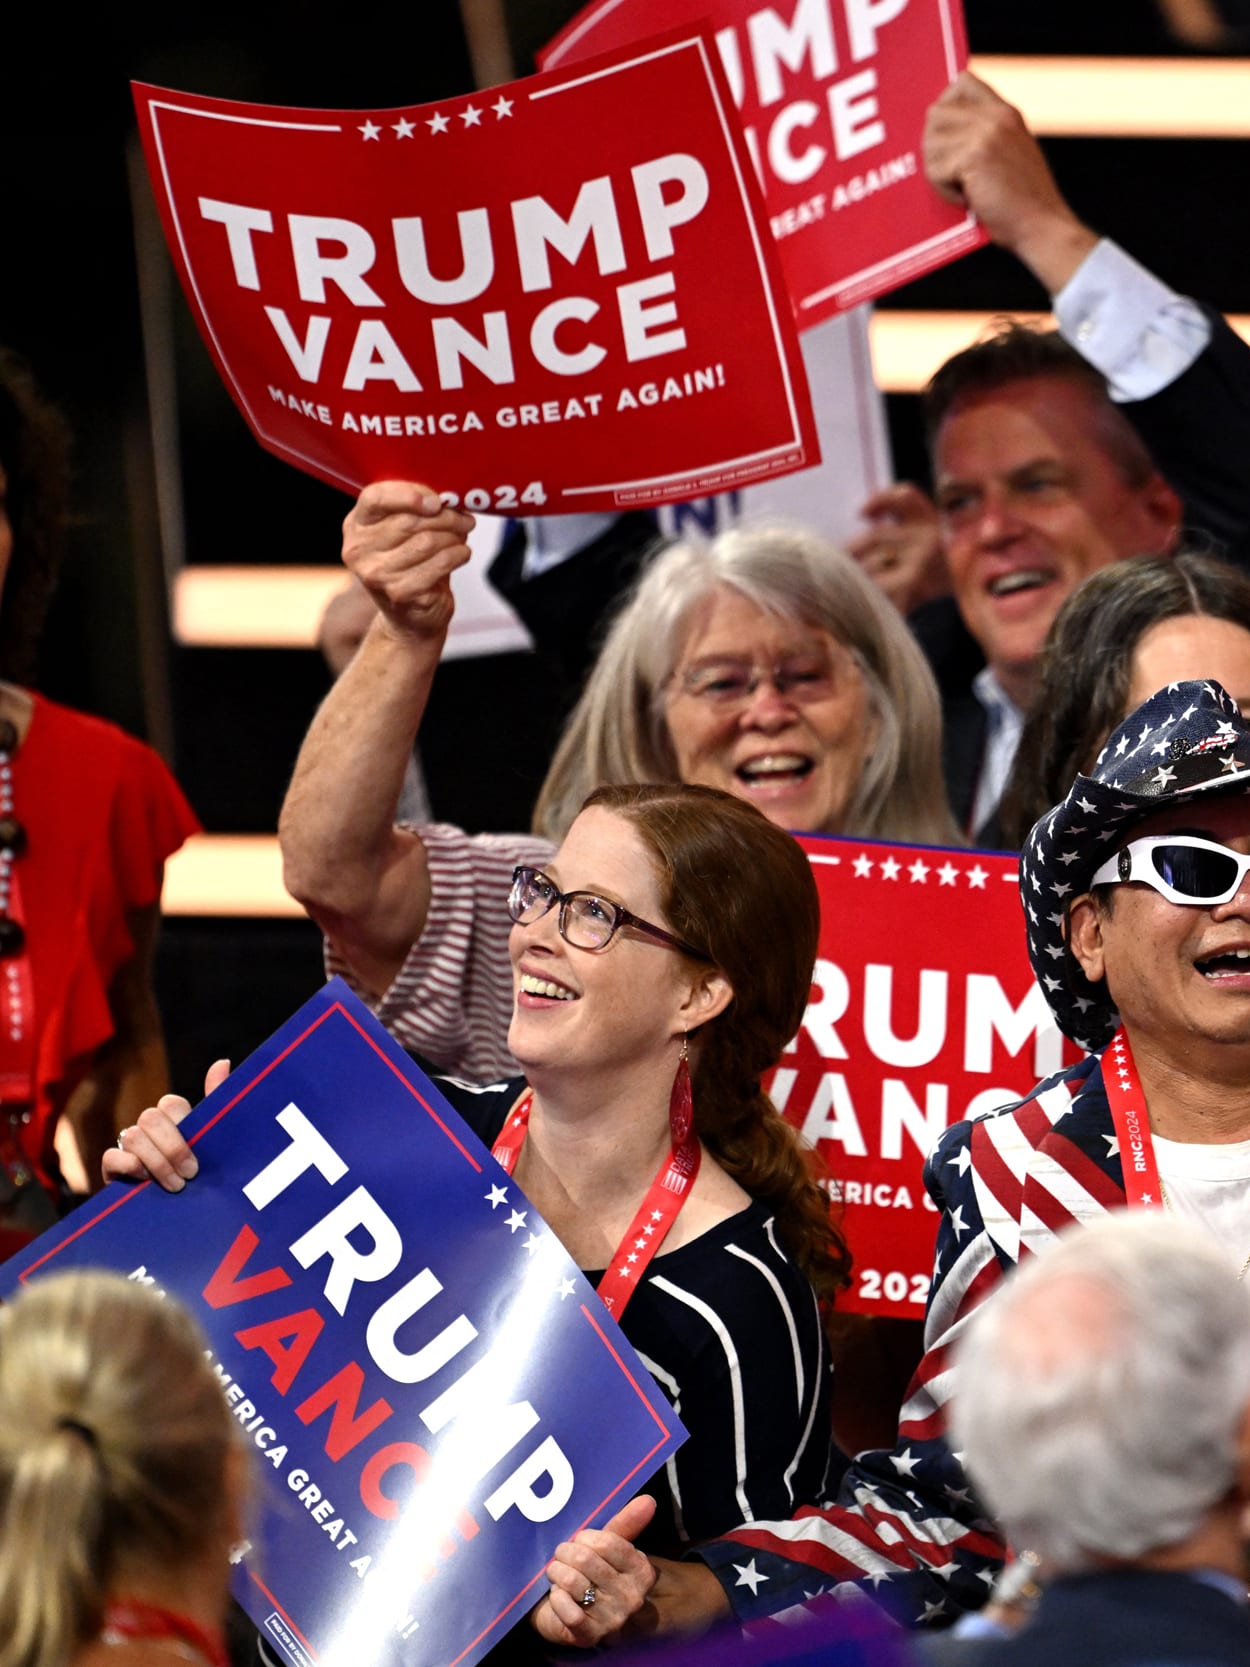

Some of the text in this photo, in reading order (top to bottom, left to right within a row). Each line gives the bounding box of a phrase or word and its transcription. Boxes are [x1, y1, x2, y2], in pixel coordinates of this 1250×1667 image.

[197, 153, 710, 308] TRUMP
[263, 271, 687, 393] VANCE
[267, 364, 727, 437] MAKE AMERICA GREAT AGAIN!
[440, 481, 547, 511] 2024
[1126, 1109, 1148, 1173] RNC2024
[817, 1178, 913, 1210] ERICA
[242, 1102, 575, 1523] TRUMP
[287, 1469, 359, 1551] GREAT
